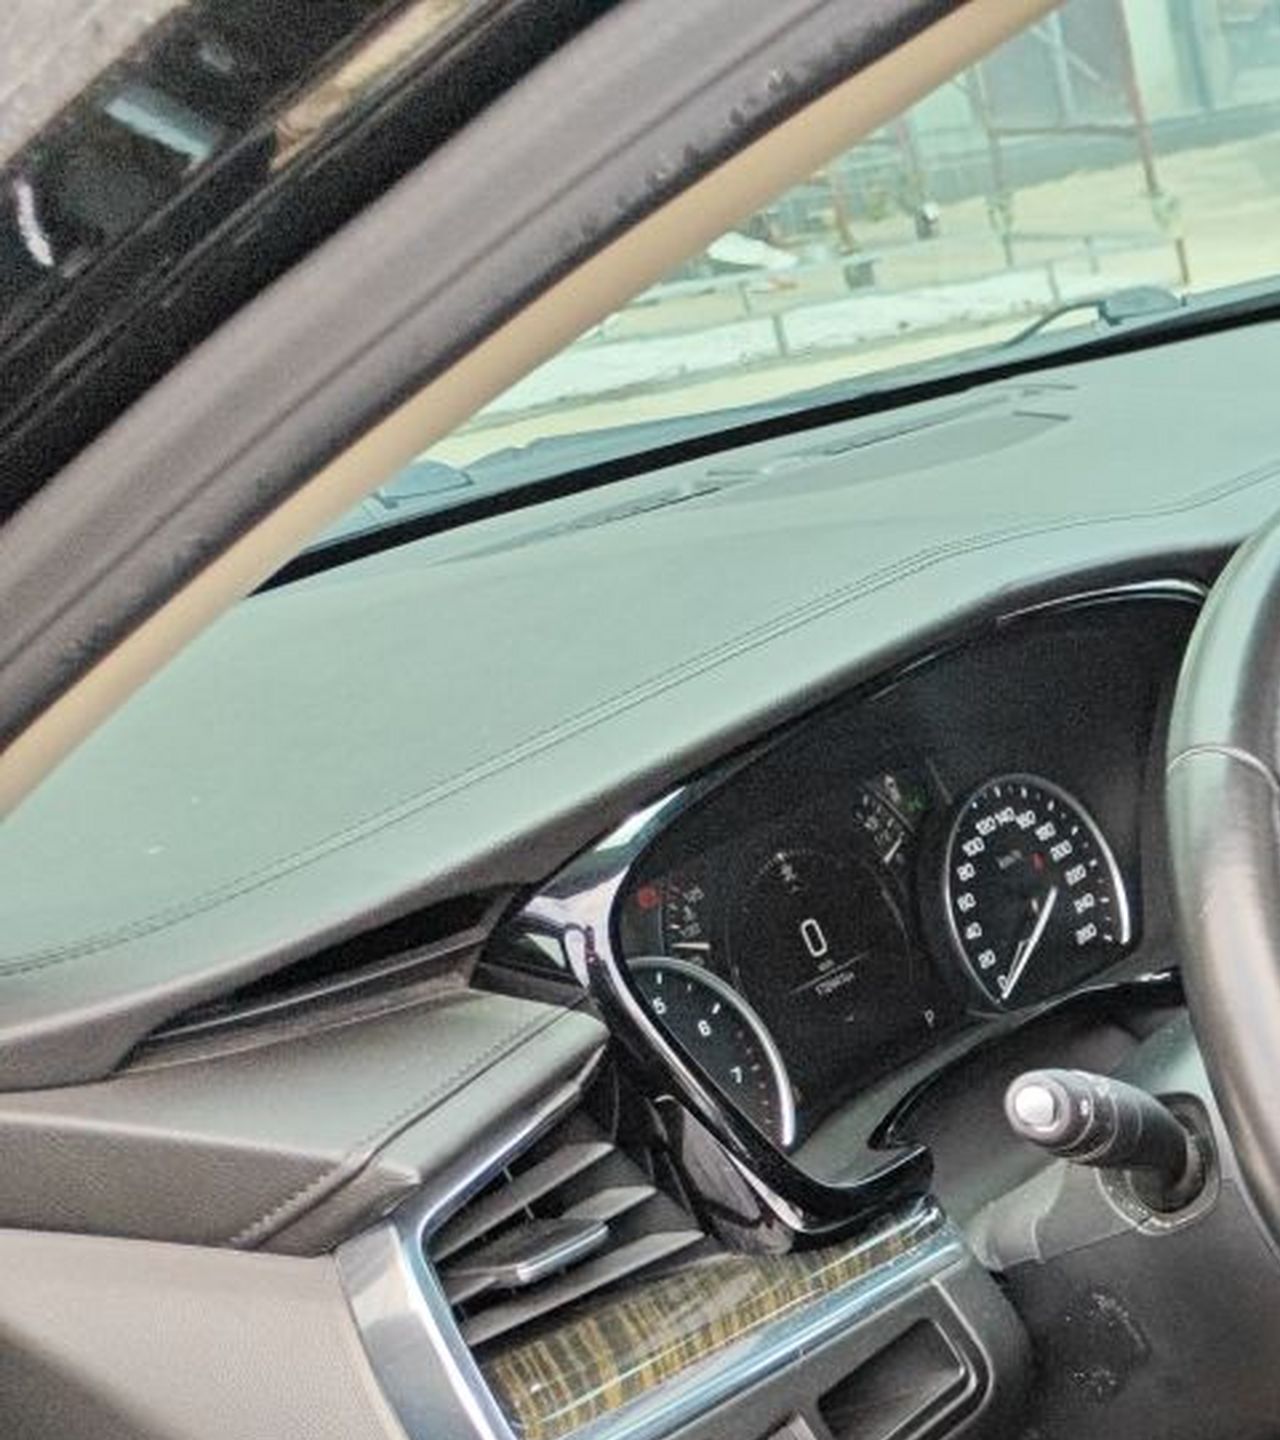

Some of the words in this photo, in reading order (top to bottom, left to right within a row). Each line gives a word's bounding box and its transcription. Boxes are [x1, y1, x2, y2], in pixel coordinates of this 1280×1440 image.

[801, 918, 827, 958] 0
[653, 997, 667, 1015] 5
[698, 1020, 711, 1037] 6
[730, 1066, 742, 1083] 7
